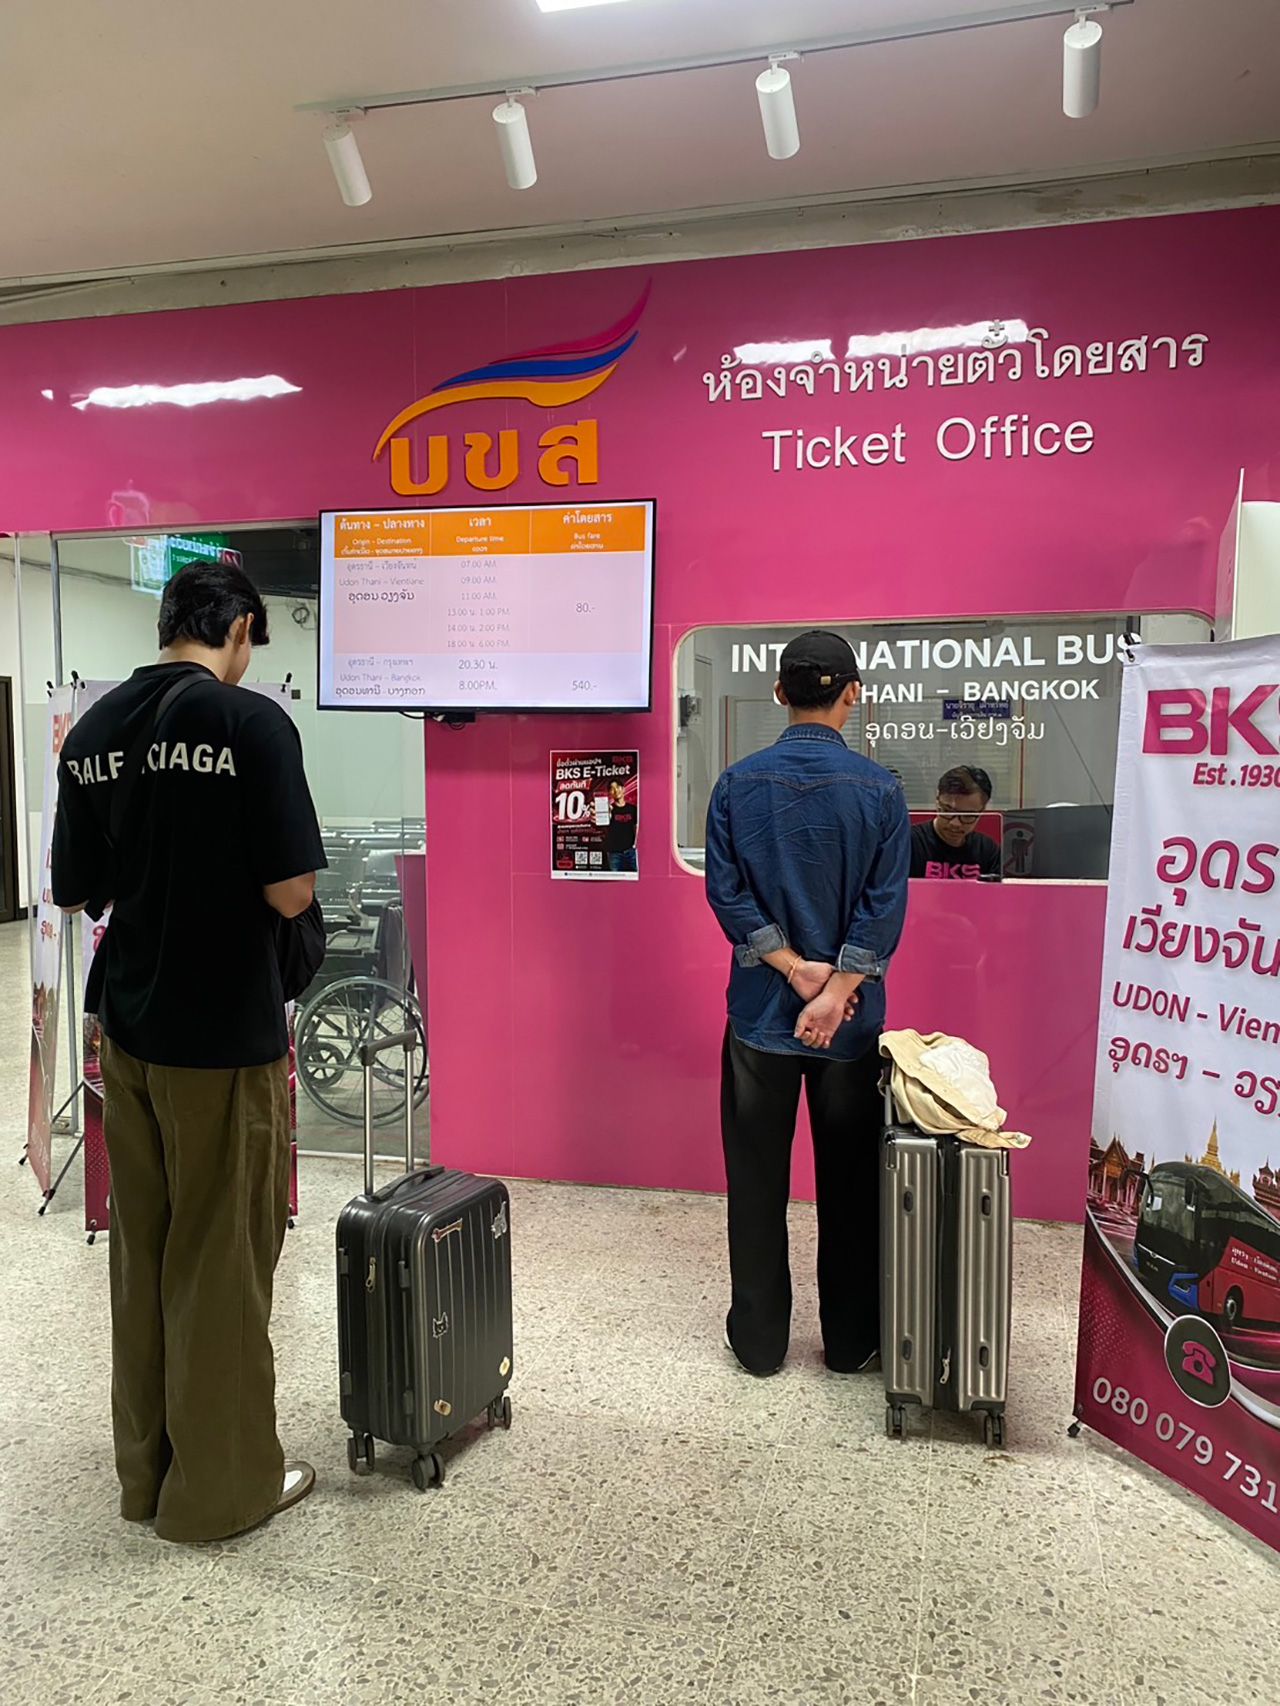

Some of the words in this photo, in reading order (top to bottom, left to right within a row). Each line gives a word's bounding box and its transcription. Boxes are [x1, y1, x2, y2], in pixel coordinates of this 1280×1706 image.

[702, 318, 1210, 402] ห้องจำหน่ายตั๋วโดยสาร
[762, 422, 907, 471] Ticket
[936, 415, 1096, 461] Office
[469, 516, 491, 528] เวลา
[563, 511, 612, 525] ค่าโดยสาร
[456, 535, 488, 544] Departure
[458, 659, 486, 670] 20.30
[731, 634, 1046, 673] INTNATIONAL
[860, 682, 924, 704] HANI
[963, 678, 1100, 702] BANGKOK
[1142, 684, 1280, 756] BK
[555, 767, 581, 780] BKS
[582, 764, 630, 778] E-Ticket
[925, 860, 981, 879] BKS
[1112, 981, 1191, 1023] UDON
[1092, 1376, 1149, 1426] 080
[1155, 1412, 1214, 1466] 079
[1222, 1450, 1278, 1514] 731
